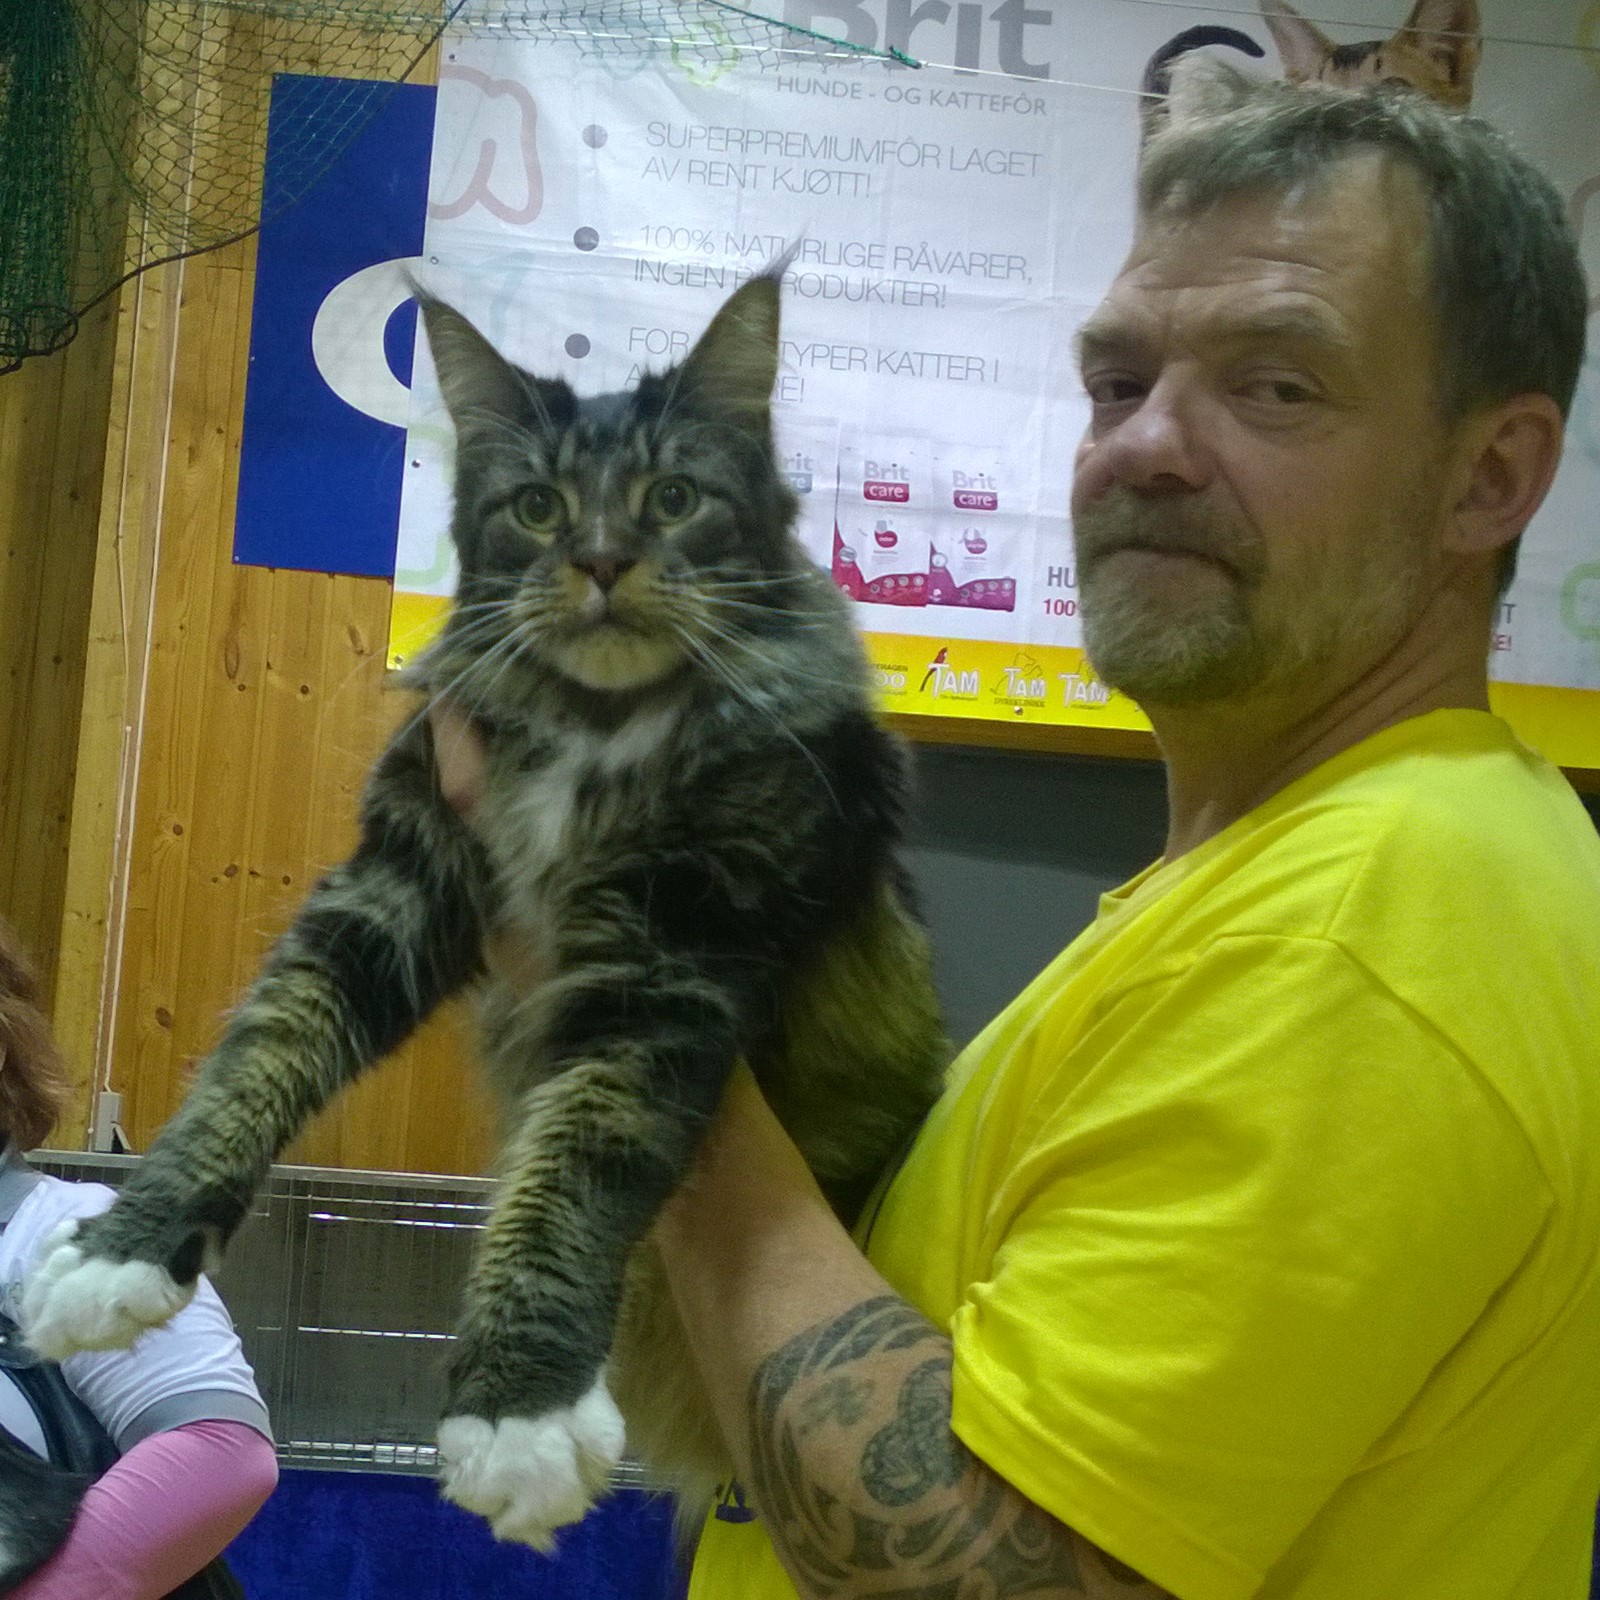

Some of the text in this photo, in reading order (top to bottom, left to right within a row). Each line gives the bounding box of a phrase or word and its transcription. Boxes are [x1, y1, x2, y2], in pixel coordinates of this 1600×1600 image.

[780, 0, 1053, 83] Brit
[777, 76, 862, 99] HUNDE
[883, 85, 922, 105] OG
[641, 156, 871, 198] AV RENT KJØTT!
[949, 146, 1044, 178] LAGET
[640, 224, 1033, 285] 100% NATURLIGE RÅVARER,
[634, 257, 725, 290] INGEN
[628, 326, 690, 355] FOR
[779, 340, 868, 372] TYPER
[876, 348, 986, 382] KATTER
[783, 452, 814, 471] rit
[863, 460, 911, 481] Brit
[869, 484, 905, 499] care
[952, 469, 997, 490] Brit
[958, 493, 993, 508] care
[927, 662, 979, 699] TAM
[1003, 666, 1046, 698] TAM
[1058, 672, 1110, 708] TAM
